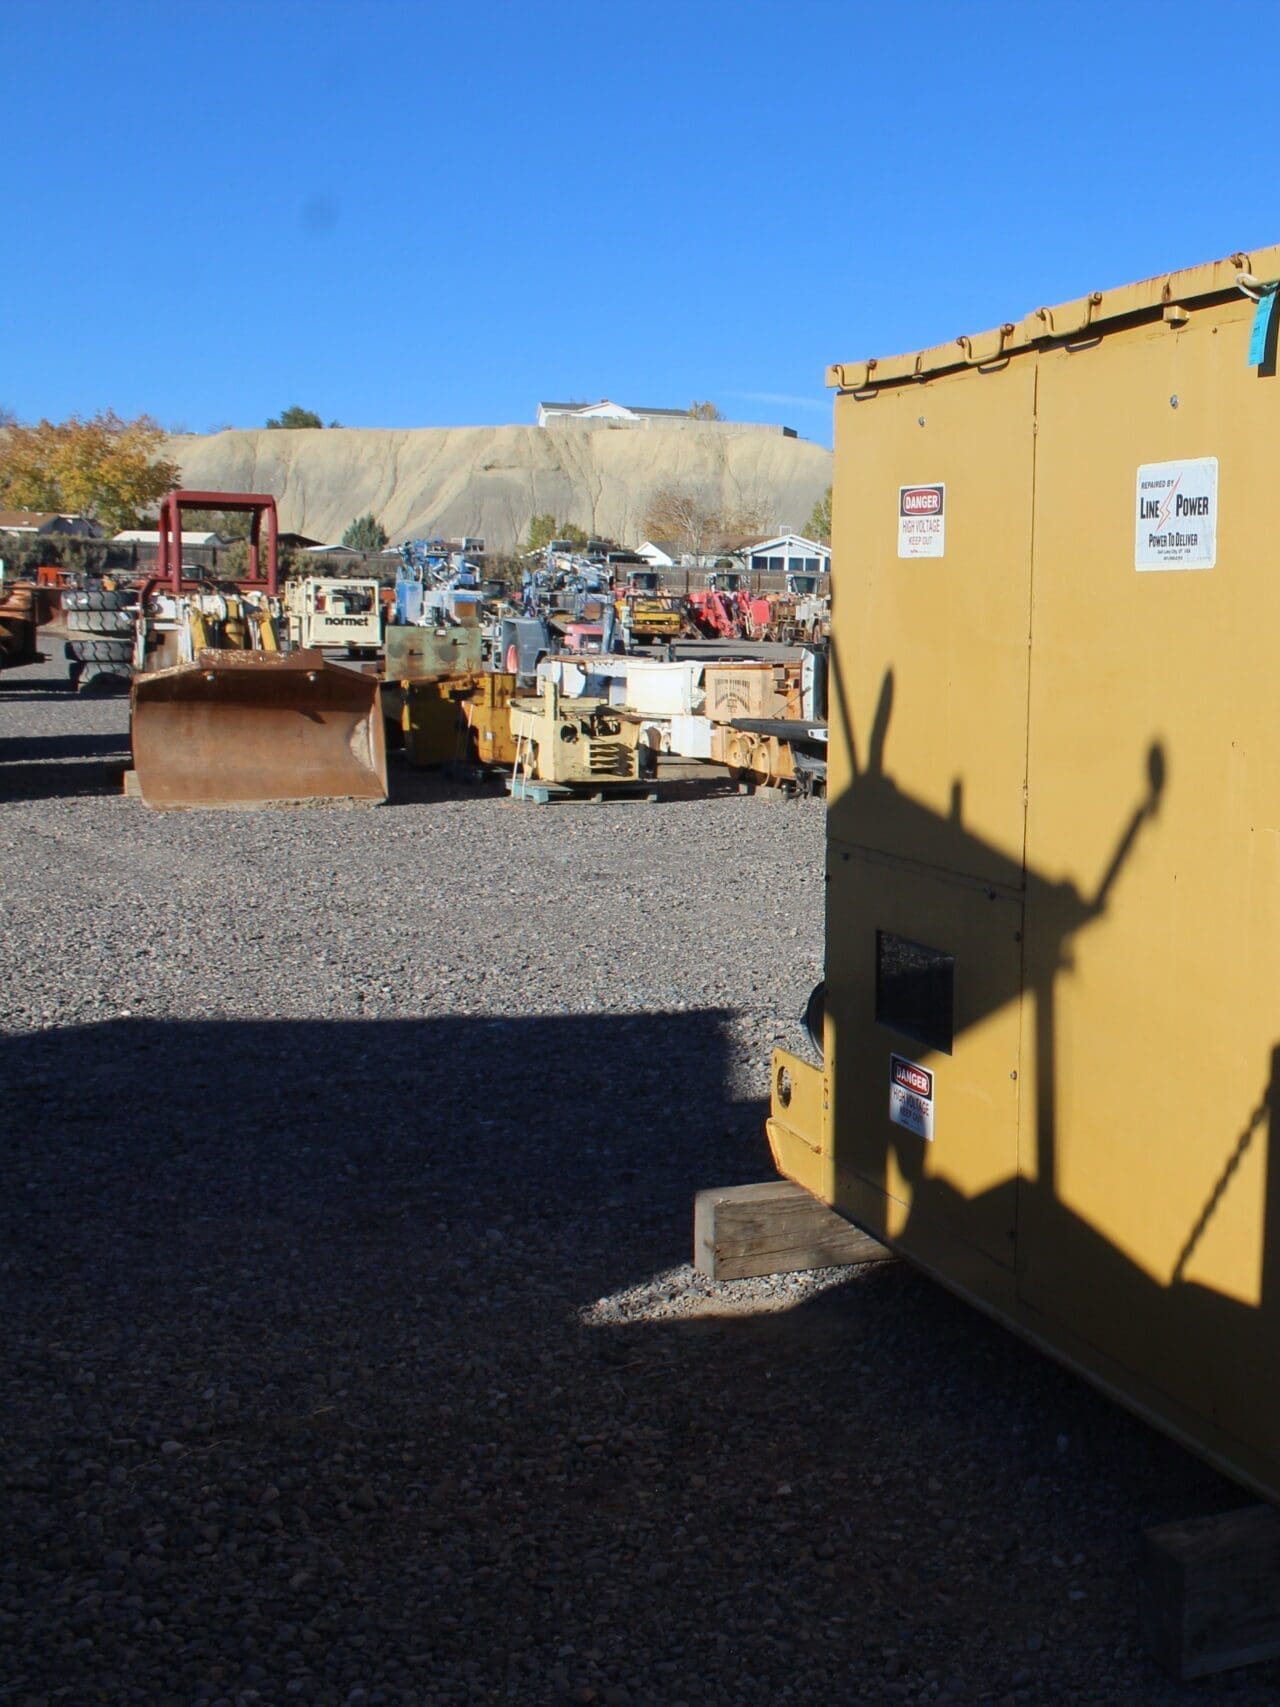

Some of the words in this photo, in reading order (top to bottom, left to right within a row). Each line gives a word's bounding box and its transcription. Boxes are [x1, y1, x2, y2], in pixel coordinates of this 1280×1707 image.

[1141, 481, 1165, 489] REPAIRED
[905, 495, 938, 510] DANGER
[325, 617, 368, 626] normet
[896, 1066, 928, 1091] DANGER
